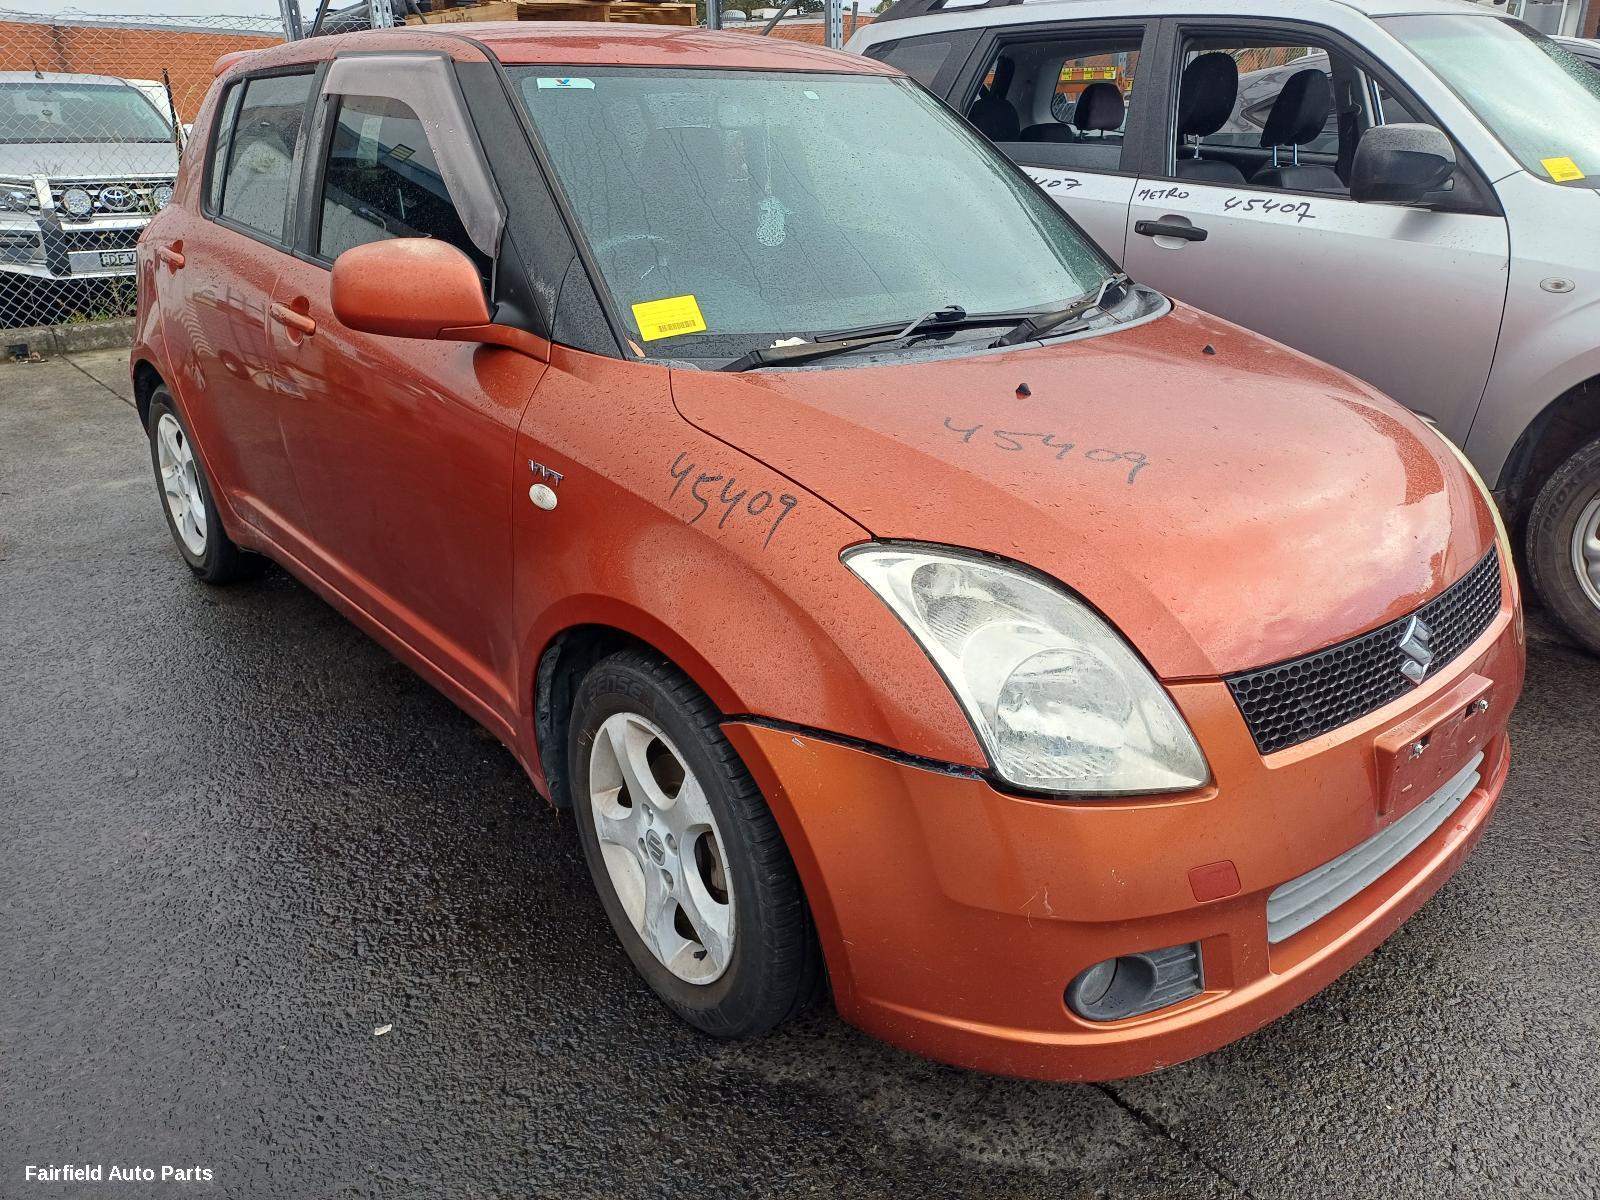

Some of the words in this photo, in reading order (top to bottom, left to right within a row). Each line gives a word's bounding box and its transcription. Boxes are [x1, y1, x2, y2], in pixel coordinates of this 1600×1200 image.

[1028, 174, 1083, 190] 407
[1138, 187, 1190, 201] METRO
[1223, 196, 1316, 224] 45407
[943, 416, 1150, 485] 45409
[528, 458, 565, 487] VVT
[668, 451, 798, 551] 45409
